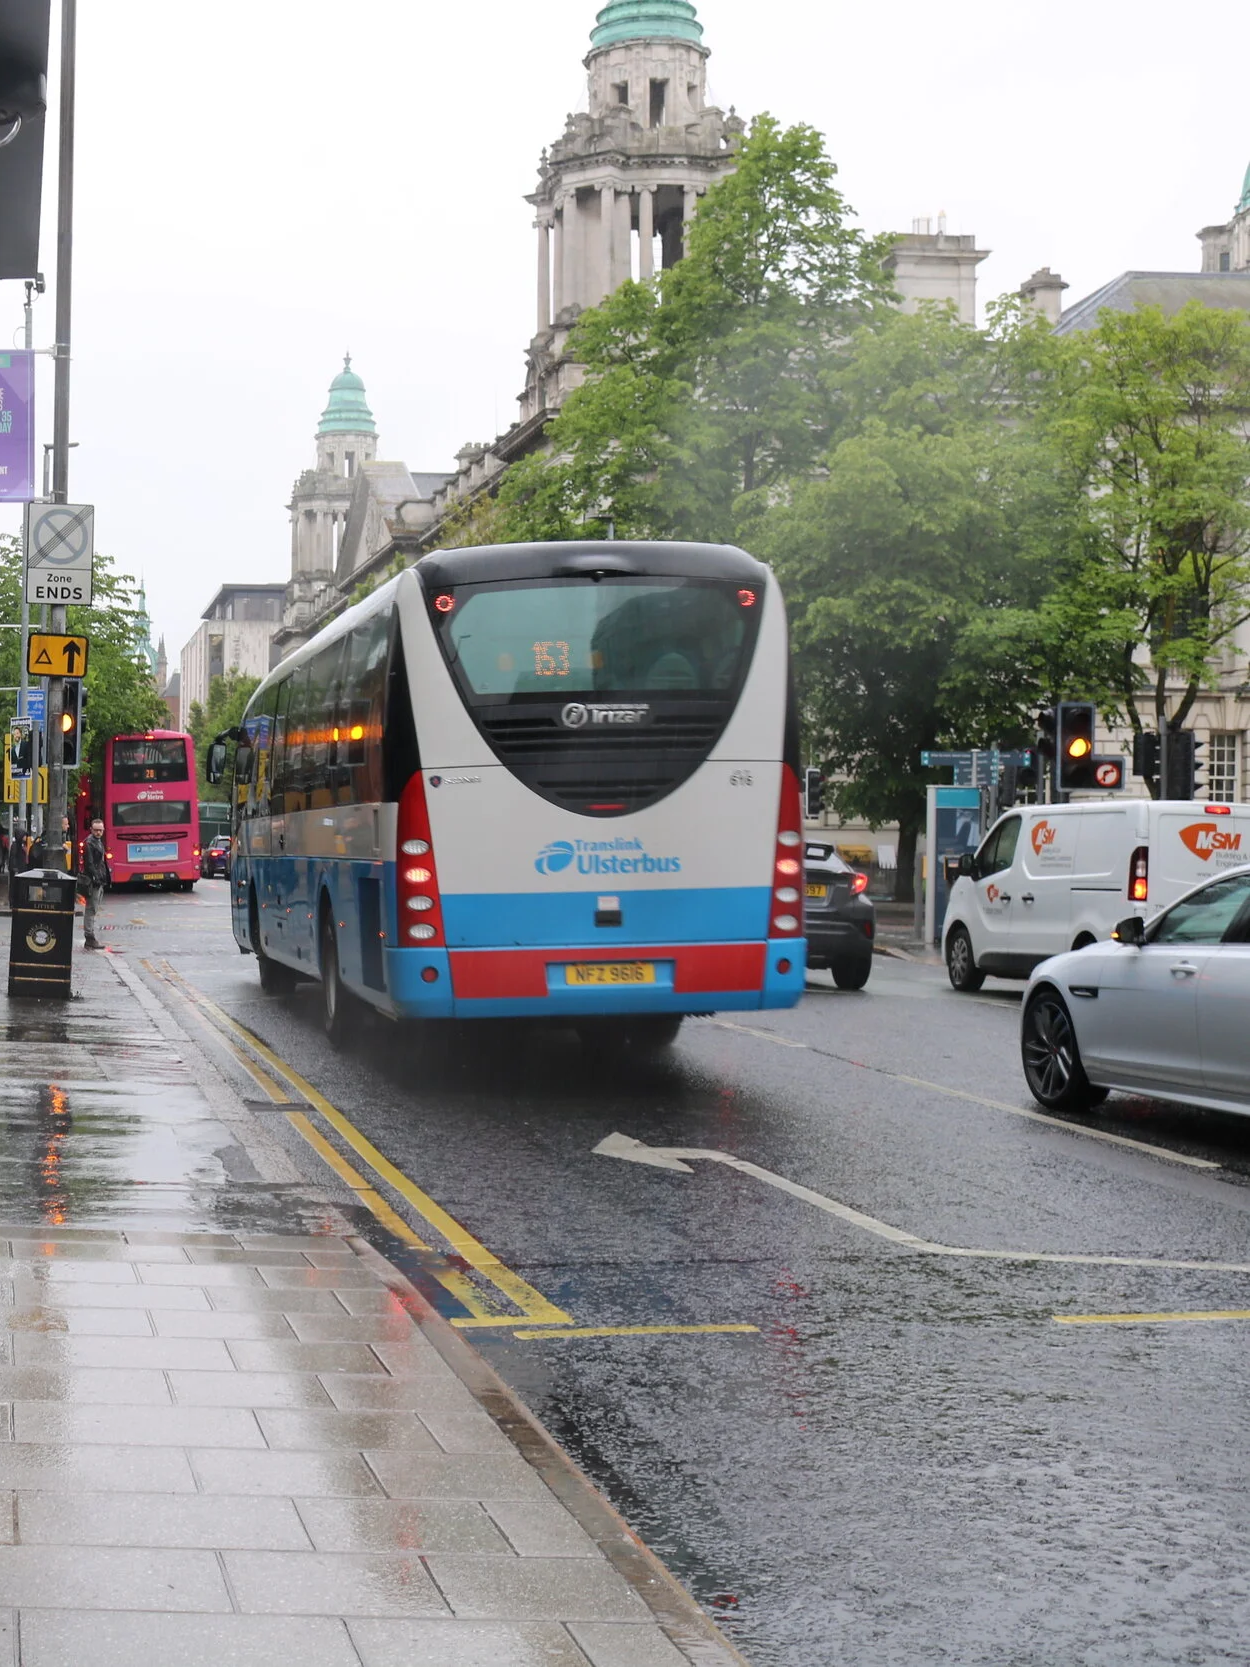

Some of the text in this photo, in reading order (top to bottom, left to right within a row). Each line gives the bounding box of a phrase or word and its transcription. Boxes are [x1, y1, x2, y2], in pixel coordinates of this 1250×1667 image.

[2, 411, 12, 422] 35
[47, 573, 72, 583] Zone
[36, 586, 83, 600] ENDS
[573, 837, 643, 851] Translink
[1196, 830, 1242, 851] MSM
[576, 853, 682, 875] Ulsterbus
[575, 966, 645, 982] NFZ 9616
